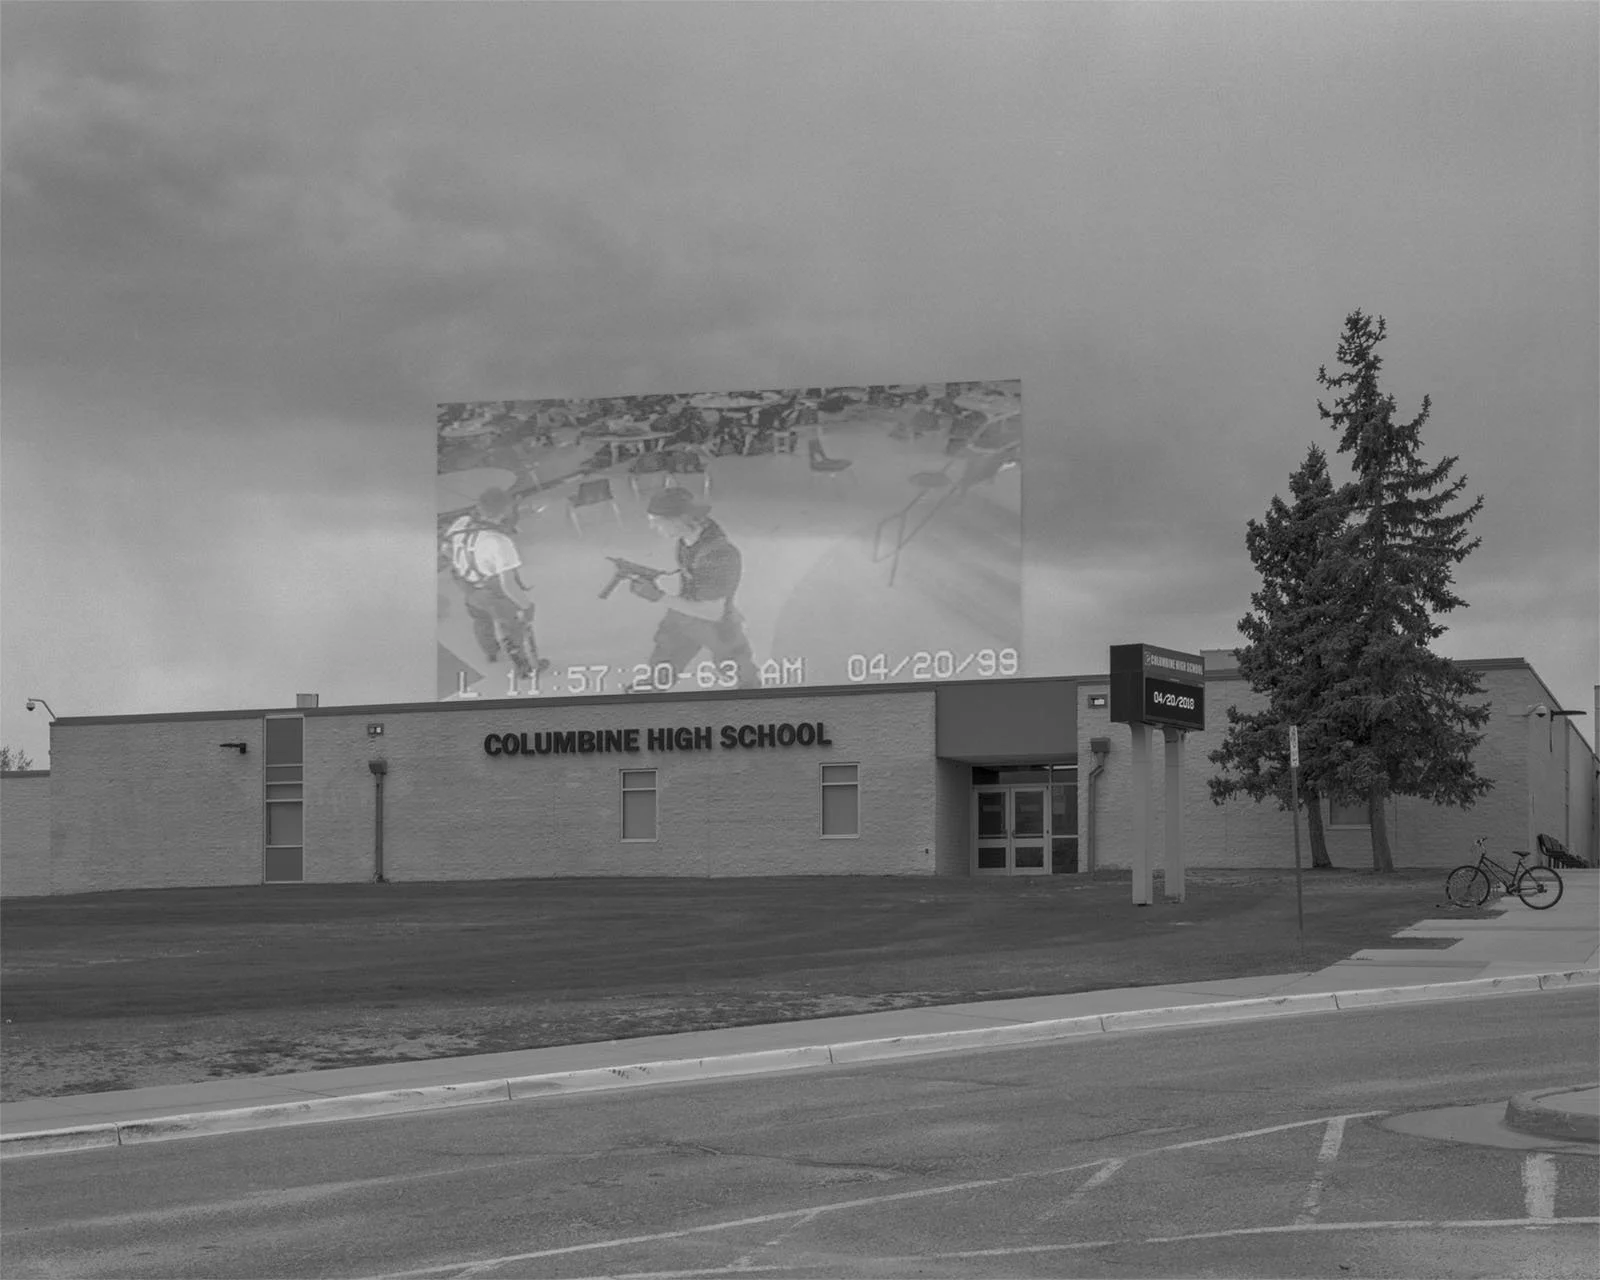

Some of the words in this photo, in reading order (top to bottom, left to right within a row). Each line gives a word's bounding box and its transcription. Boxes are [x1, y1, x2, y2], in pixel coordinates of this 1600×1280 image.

[1153, 691, 1195, 710] 04/20/2018
[484, 727, 640, 757] COLUMBINE
[647, 726, 713, 751] HIGH
[719, 721, 832, 748] SCHOOL
